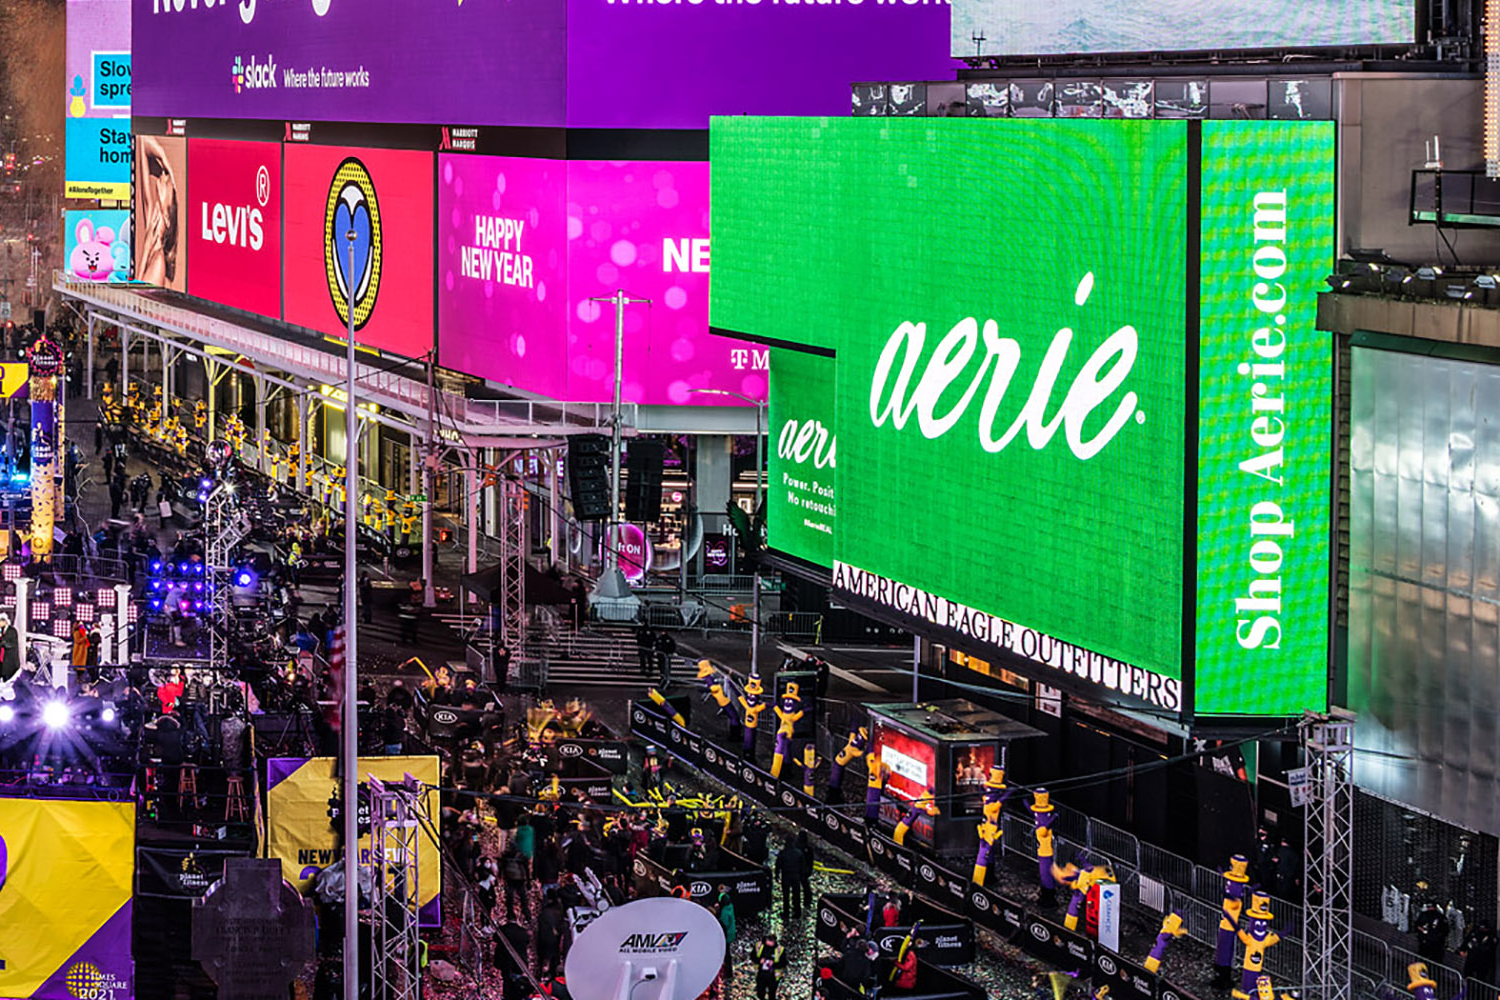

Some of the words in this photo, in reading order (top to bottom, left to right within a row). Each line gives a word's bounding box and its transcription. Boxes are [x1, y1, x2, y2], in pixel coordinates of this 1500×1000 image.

[245, 53, 277, 90] slack
[283, 68, 307, 87] Where
[307, 68, 320, 87] the
[321, 67, 345, 88] future
[345, 66, 370, 87] works
[475, 214, 524, 252] HAPPY
[461, 246, 495, 282] NEW
[492, 253, 534, 289] YEAR
[663, 238, 710, 273] NE
[1238, 186, 1289, 488] Aerie.com
[870, 271, 1138, 461] aerie
[787, 490, 799, 506] No
[801, 498, 837, 517] retouchi
[812, 480, 836, 499] Posit
[1235, 500, 1295, 651] Shop
[832, 562, 940, 627] AMERICAN
[945, 597, 1017, 654] EAGLE
[1020, 625, 1181, 711] OUTFITTERS
[298, 849, 331, 865] NEW
